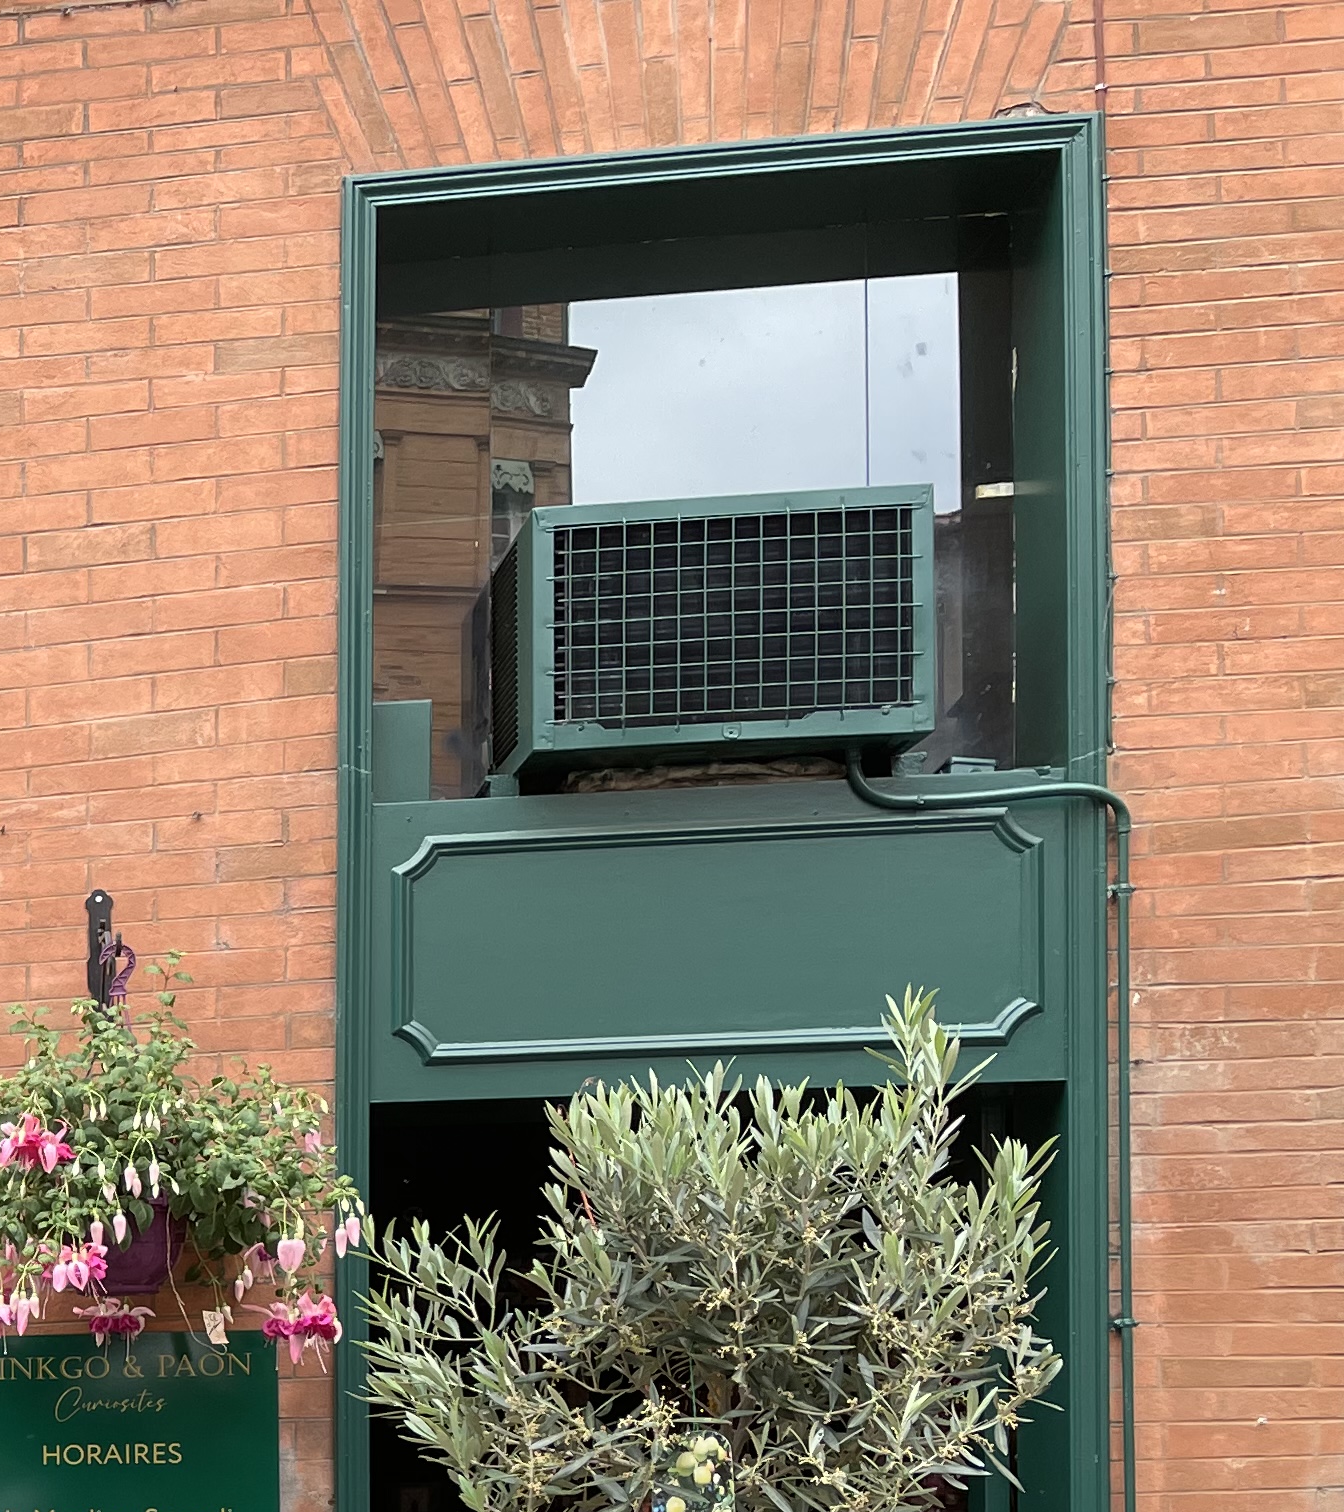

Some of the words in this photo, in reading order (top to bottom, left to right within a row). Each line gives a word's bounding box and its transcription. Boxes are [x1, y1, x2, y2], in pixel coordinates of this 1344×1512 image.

[123, 1354, 145, 1378] &
[158, 1352, 252, 1377] PAON
[42, 1442, 182, 1465] HORAIRES
